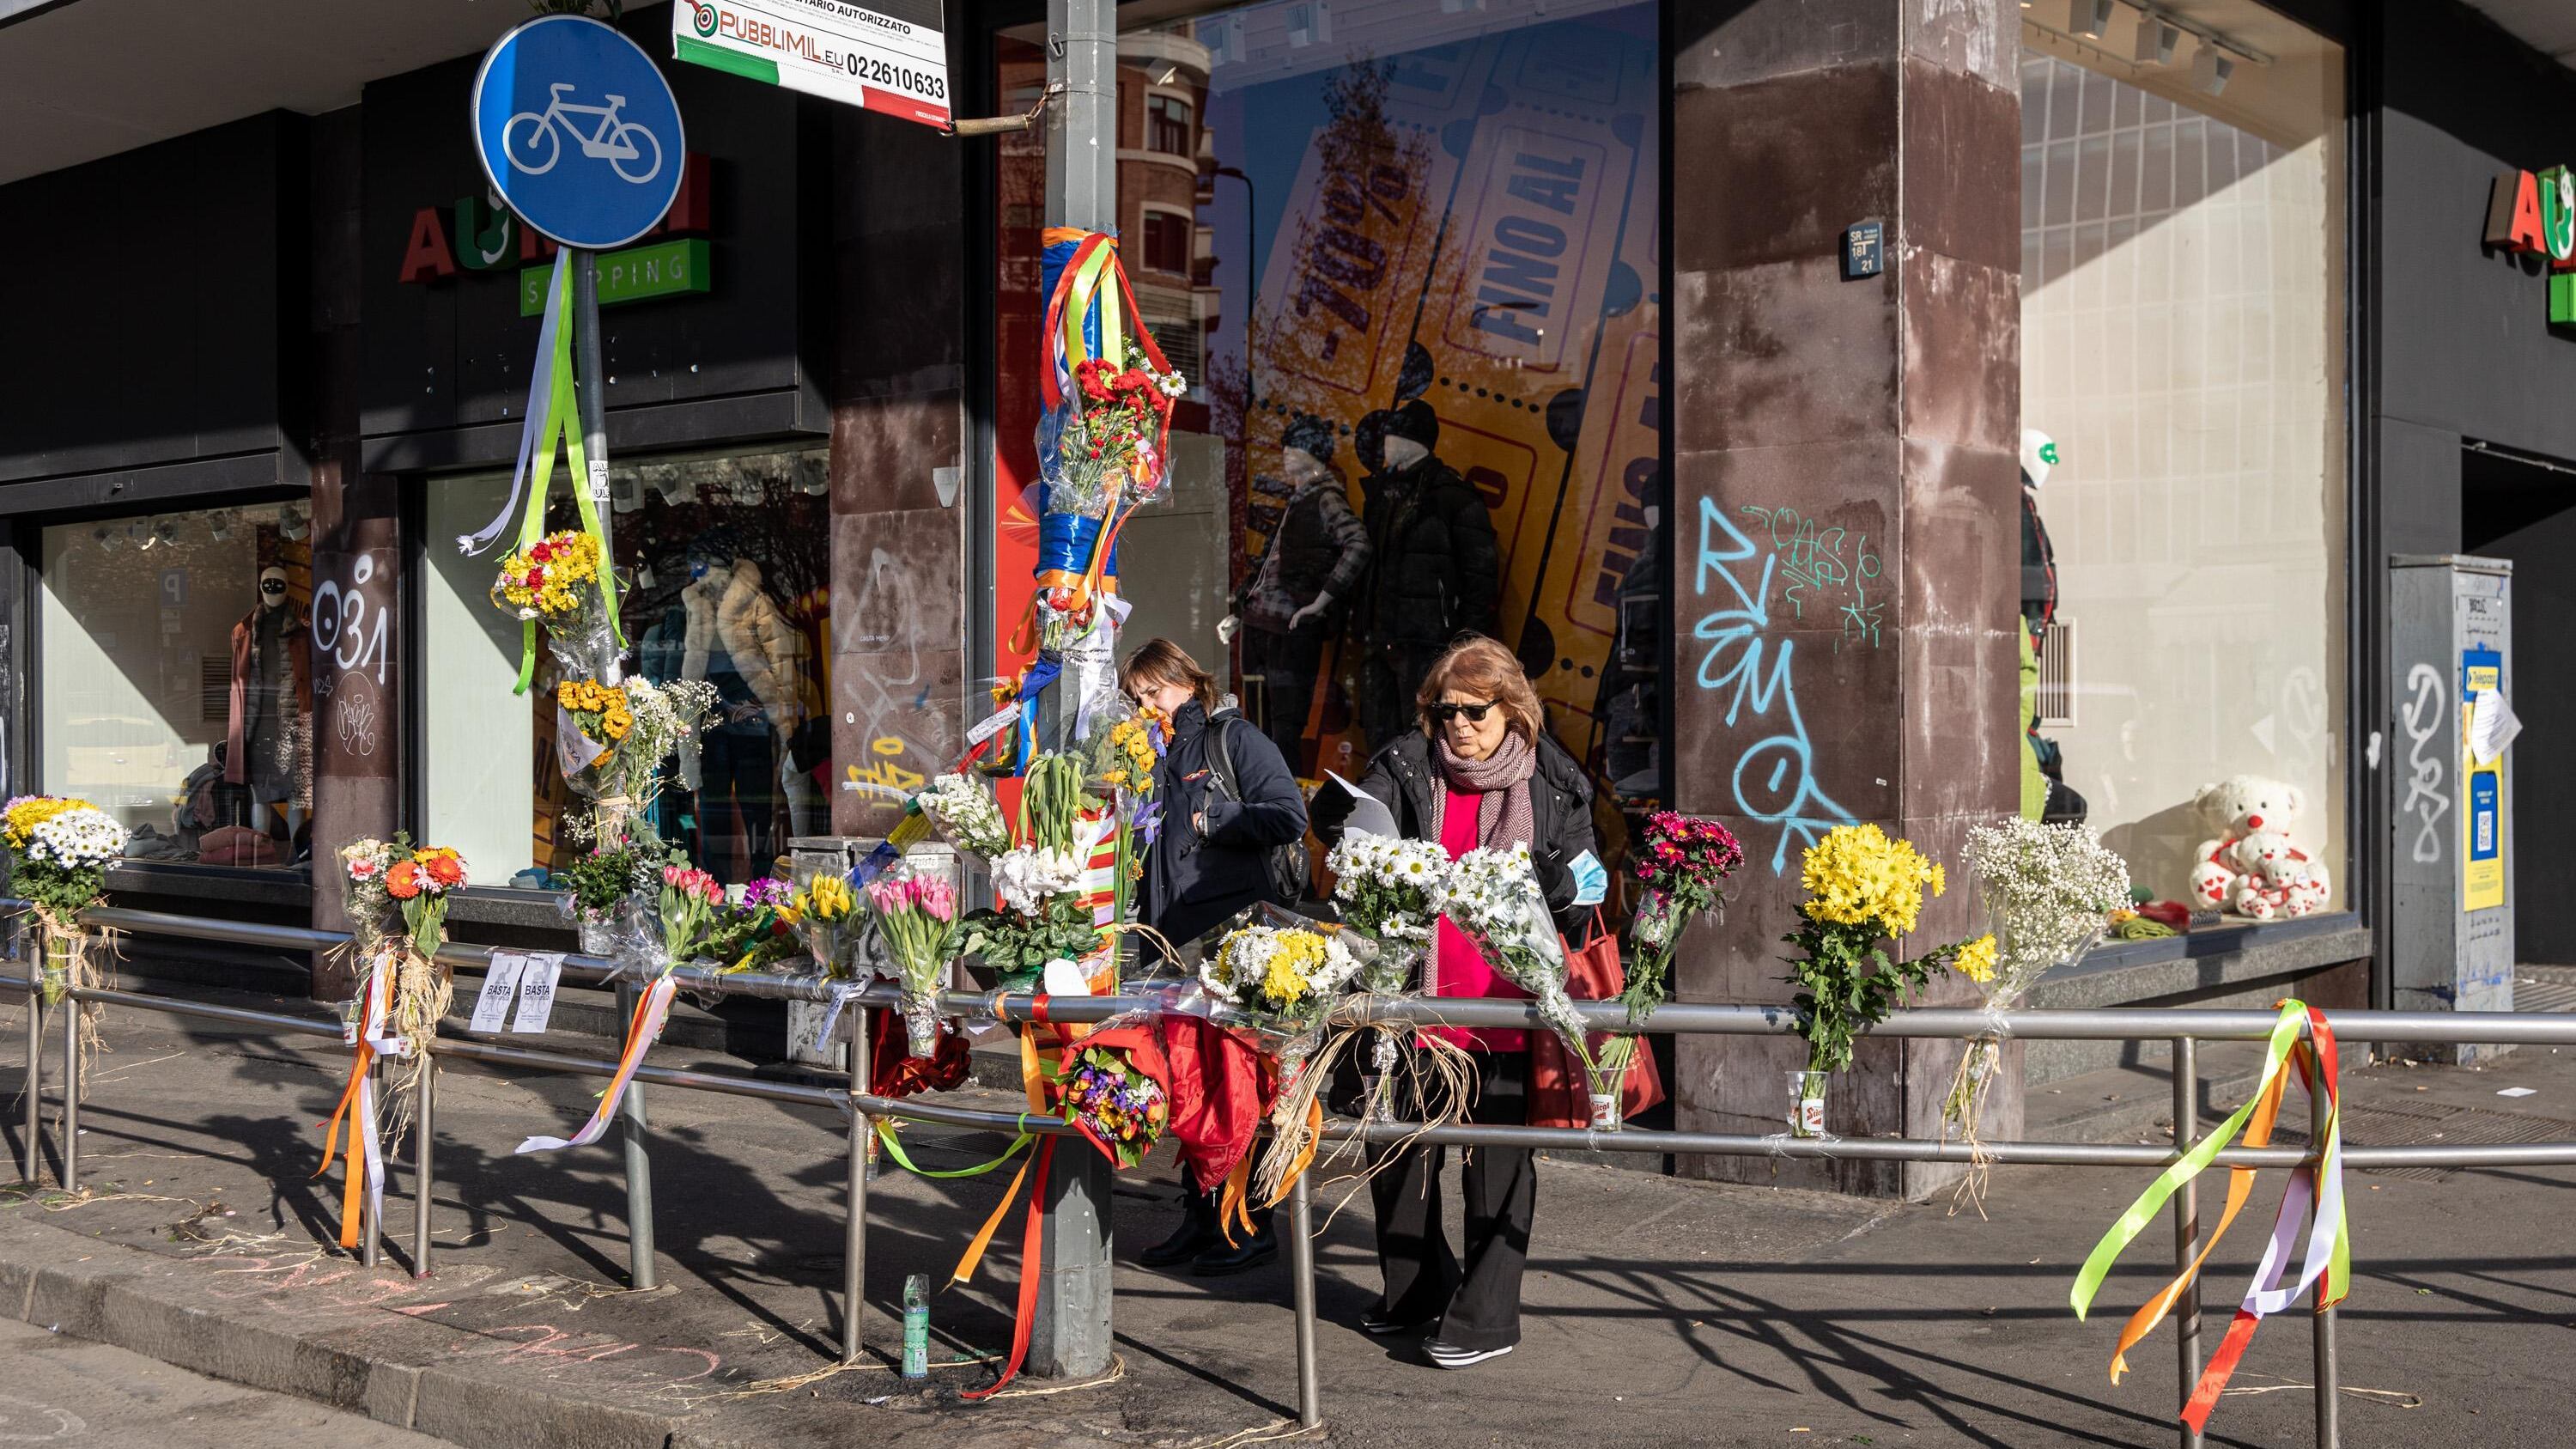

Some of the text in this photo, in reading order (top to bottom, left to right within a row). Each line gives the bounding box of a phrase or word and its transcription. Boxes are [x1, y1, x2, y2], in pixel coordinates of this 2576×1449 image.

[837, 5, 911, 35] AUTORIZZATO
[1850, 230, 1862, 241] SR
[528, 260, 683, 305] SPING
[487, 984, 511, 996] BASTA
[525, 984, 550, 996] BASTA
